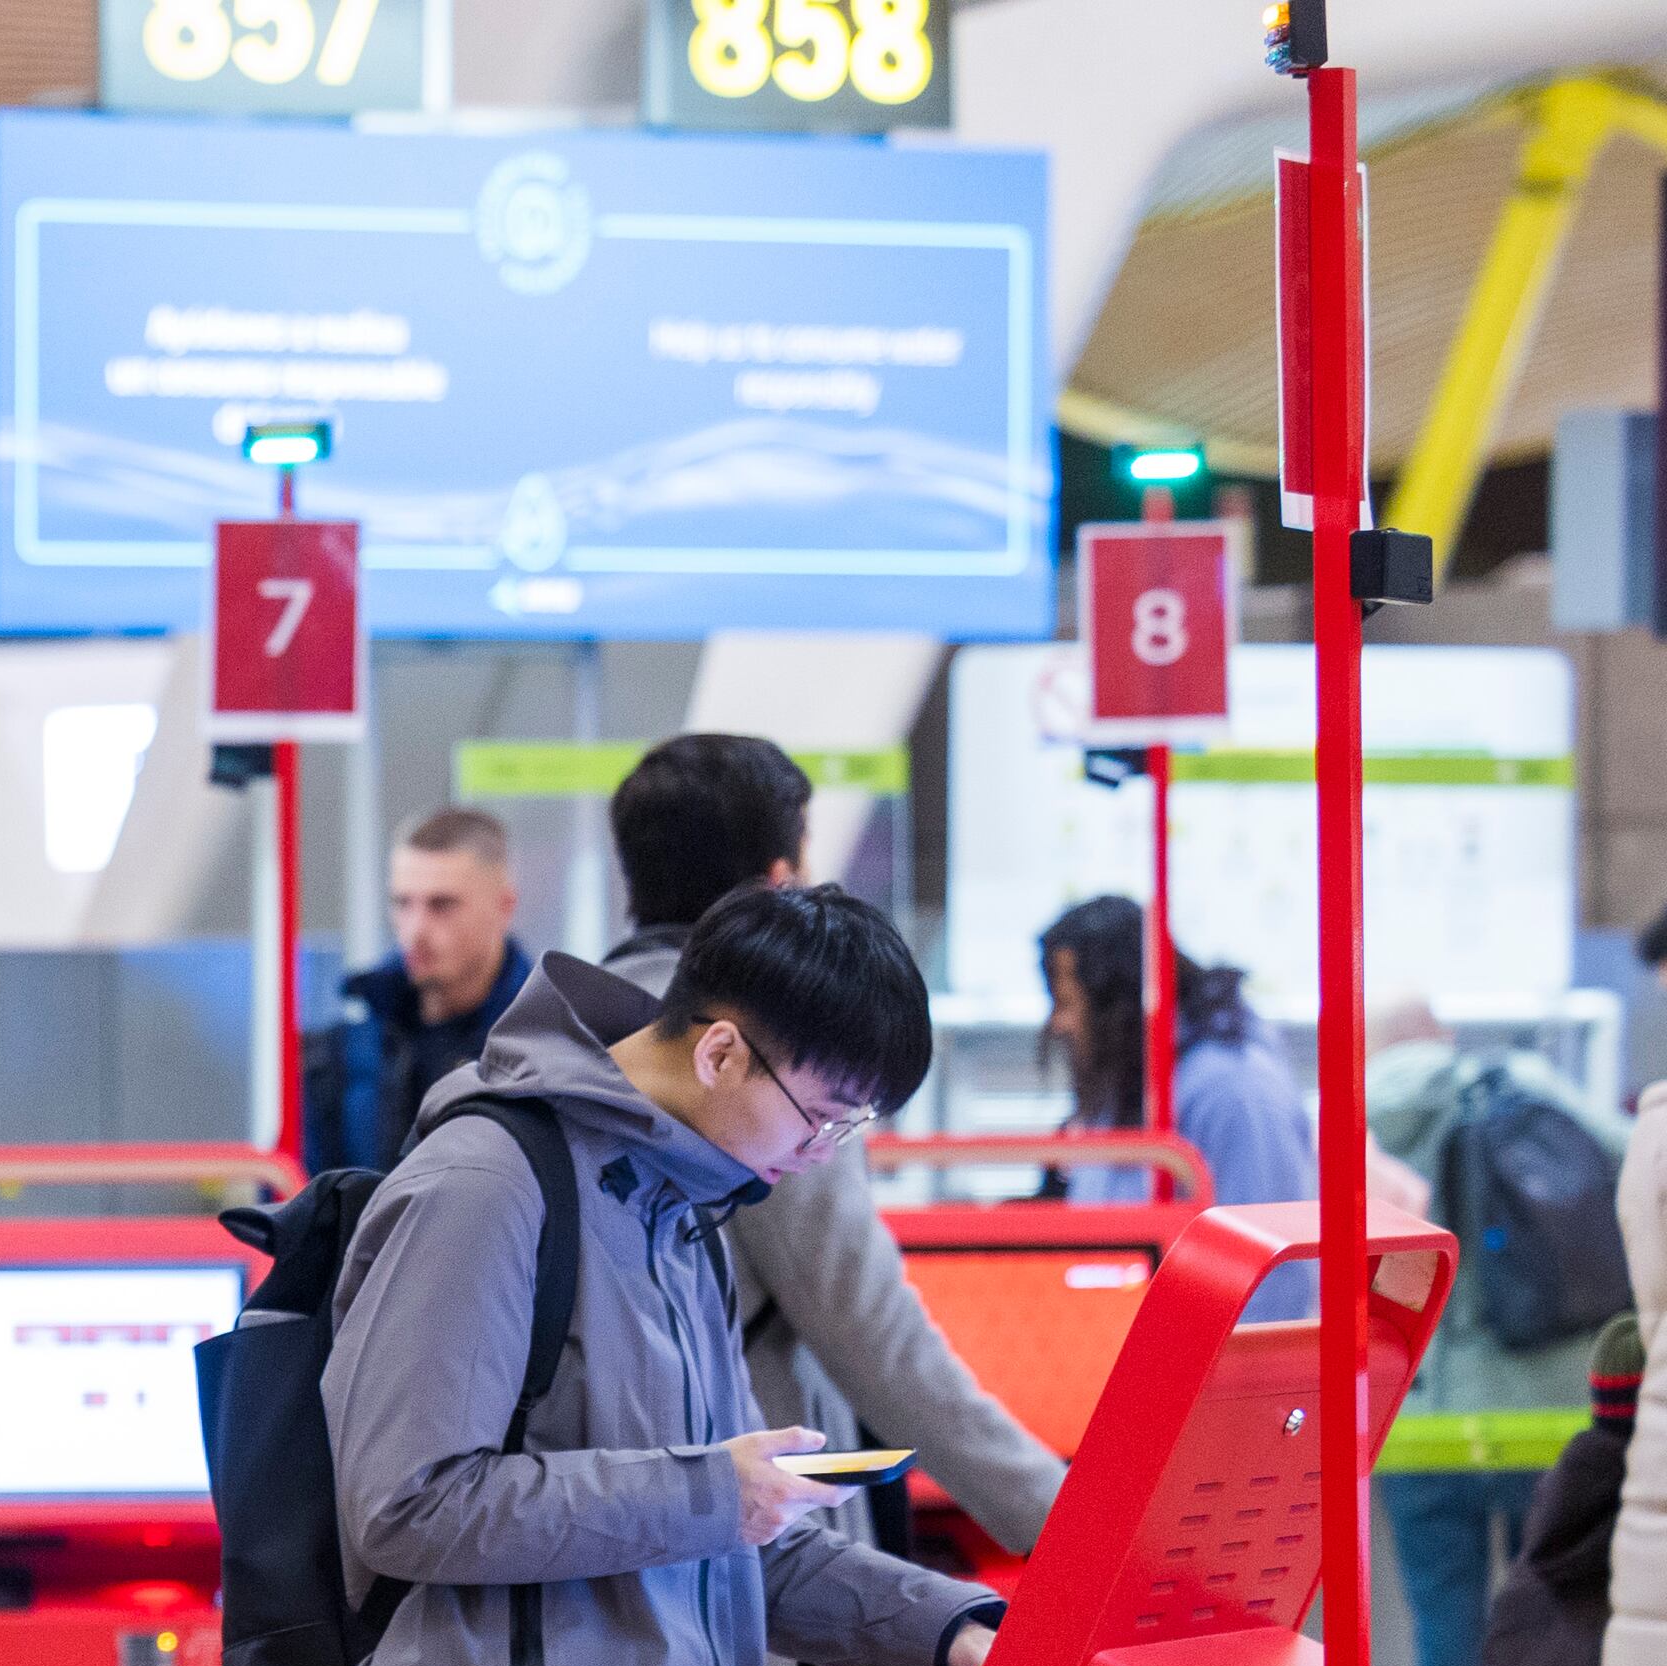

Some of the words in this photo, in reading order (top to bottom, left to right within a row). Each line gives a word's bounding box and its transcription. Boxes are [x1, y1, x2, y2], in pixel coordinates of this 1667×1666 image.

[687, 0, 936, 105] 858
[258, 578, 315, 659] 7
[1130, 588, 1188, 667] 8
